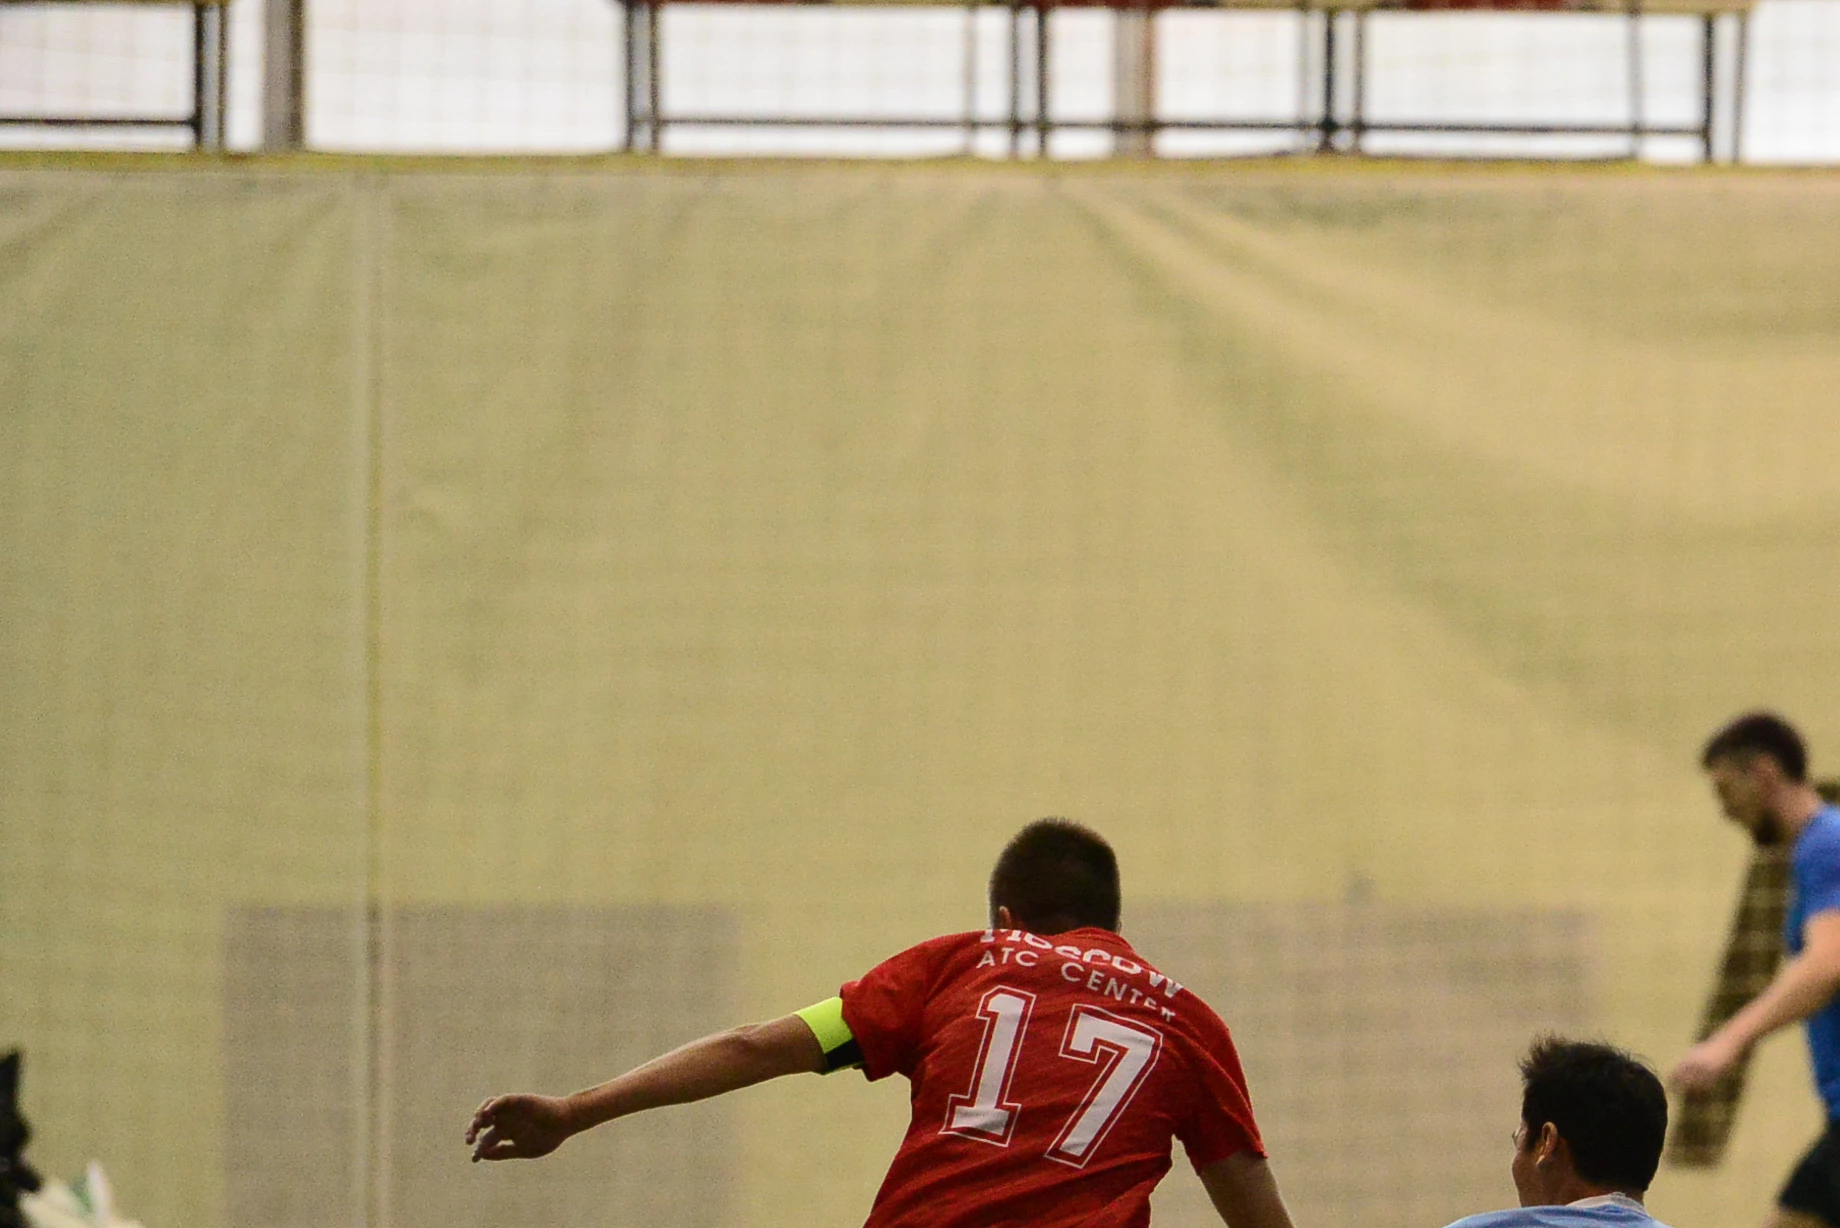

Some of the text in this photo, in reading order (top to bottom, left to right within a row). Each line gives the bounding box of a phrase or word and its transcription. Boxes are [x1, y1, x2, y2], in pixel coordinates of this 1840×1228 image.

[976, 947, 1176, 1023] ATC CENTER
[938, 985, 1164, 1169] 17
